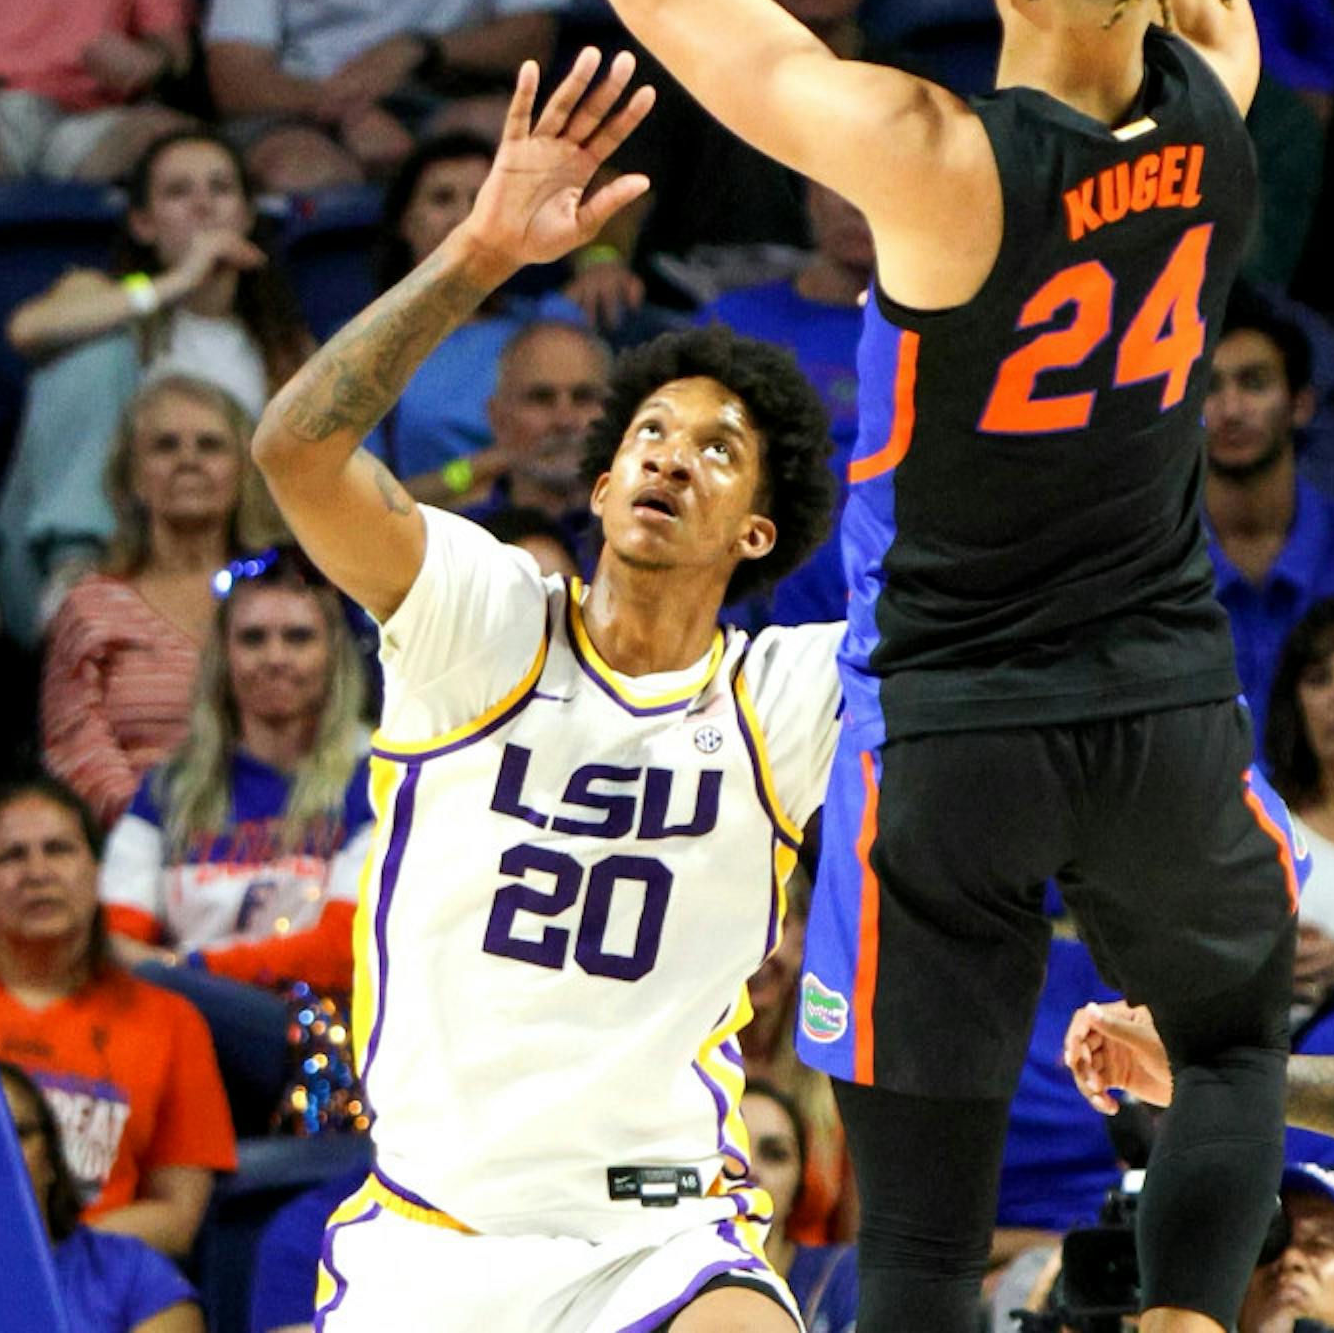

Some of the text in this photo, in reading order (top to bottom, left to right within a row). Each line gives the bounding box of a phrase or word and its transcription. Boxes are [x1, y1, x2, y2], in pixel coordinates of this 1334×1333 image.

[1063, 145, 1205, 243] KUGEL
[976, 223, 1215, 436] 24
[490, 742, 723, 840] LSU
[482, 843, 674, 983] 20
